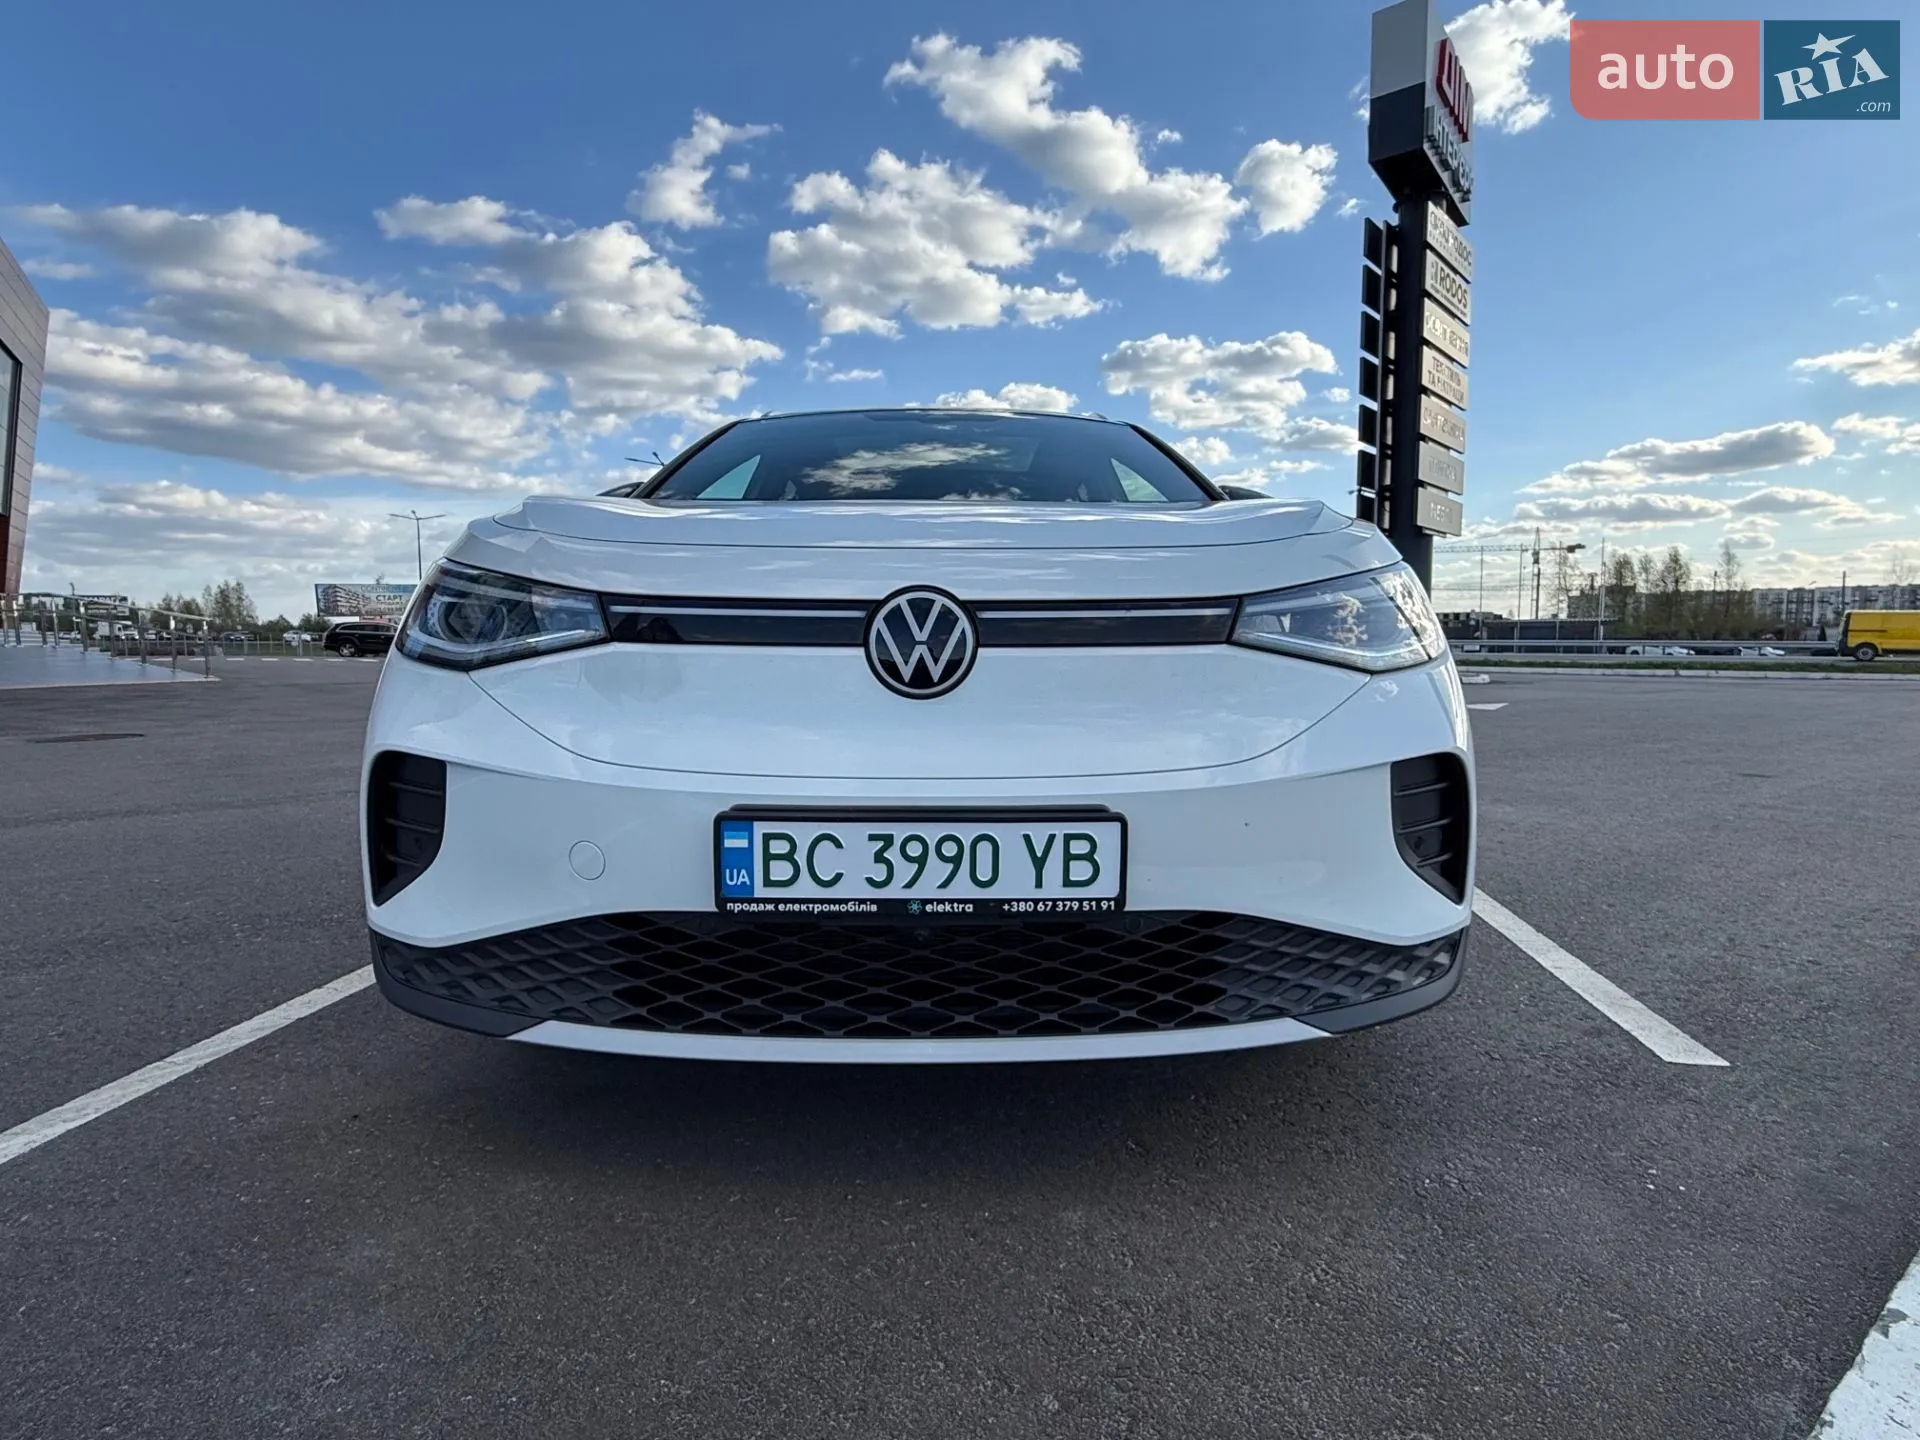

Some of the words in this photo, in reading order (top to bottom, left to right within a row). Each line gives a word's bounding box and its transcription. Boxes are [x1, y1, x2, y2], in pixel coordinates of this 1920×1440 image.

[1439, 267, 1469, 309] RODOS
[375, 594, 403, 602] СТАРТ
[761, 832, 844, 889] BC
[864, 832, 1001, 890] 3990
[1022, 832, 1101, 889] YB
[726, 869, 750, 886] UA
[726, 902, 776, 914] продаж
[778, 901, 878, 913] електромобілів
[924, 901, 974, 914] elektra
[1002, 901, 1034, 913] +380
[1036, 901, 1053, 913] 67
[1055, 901, 1080, 913] 379
[1082, 901, 1097, 912] 51
[1100, 900, 1116, 912] 91
